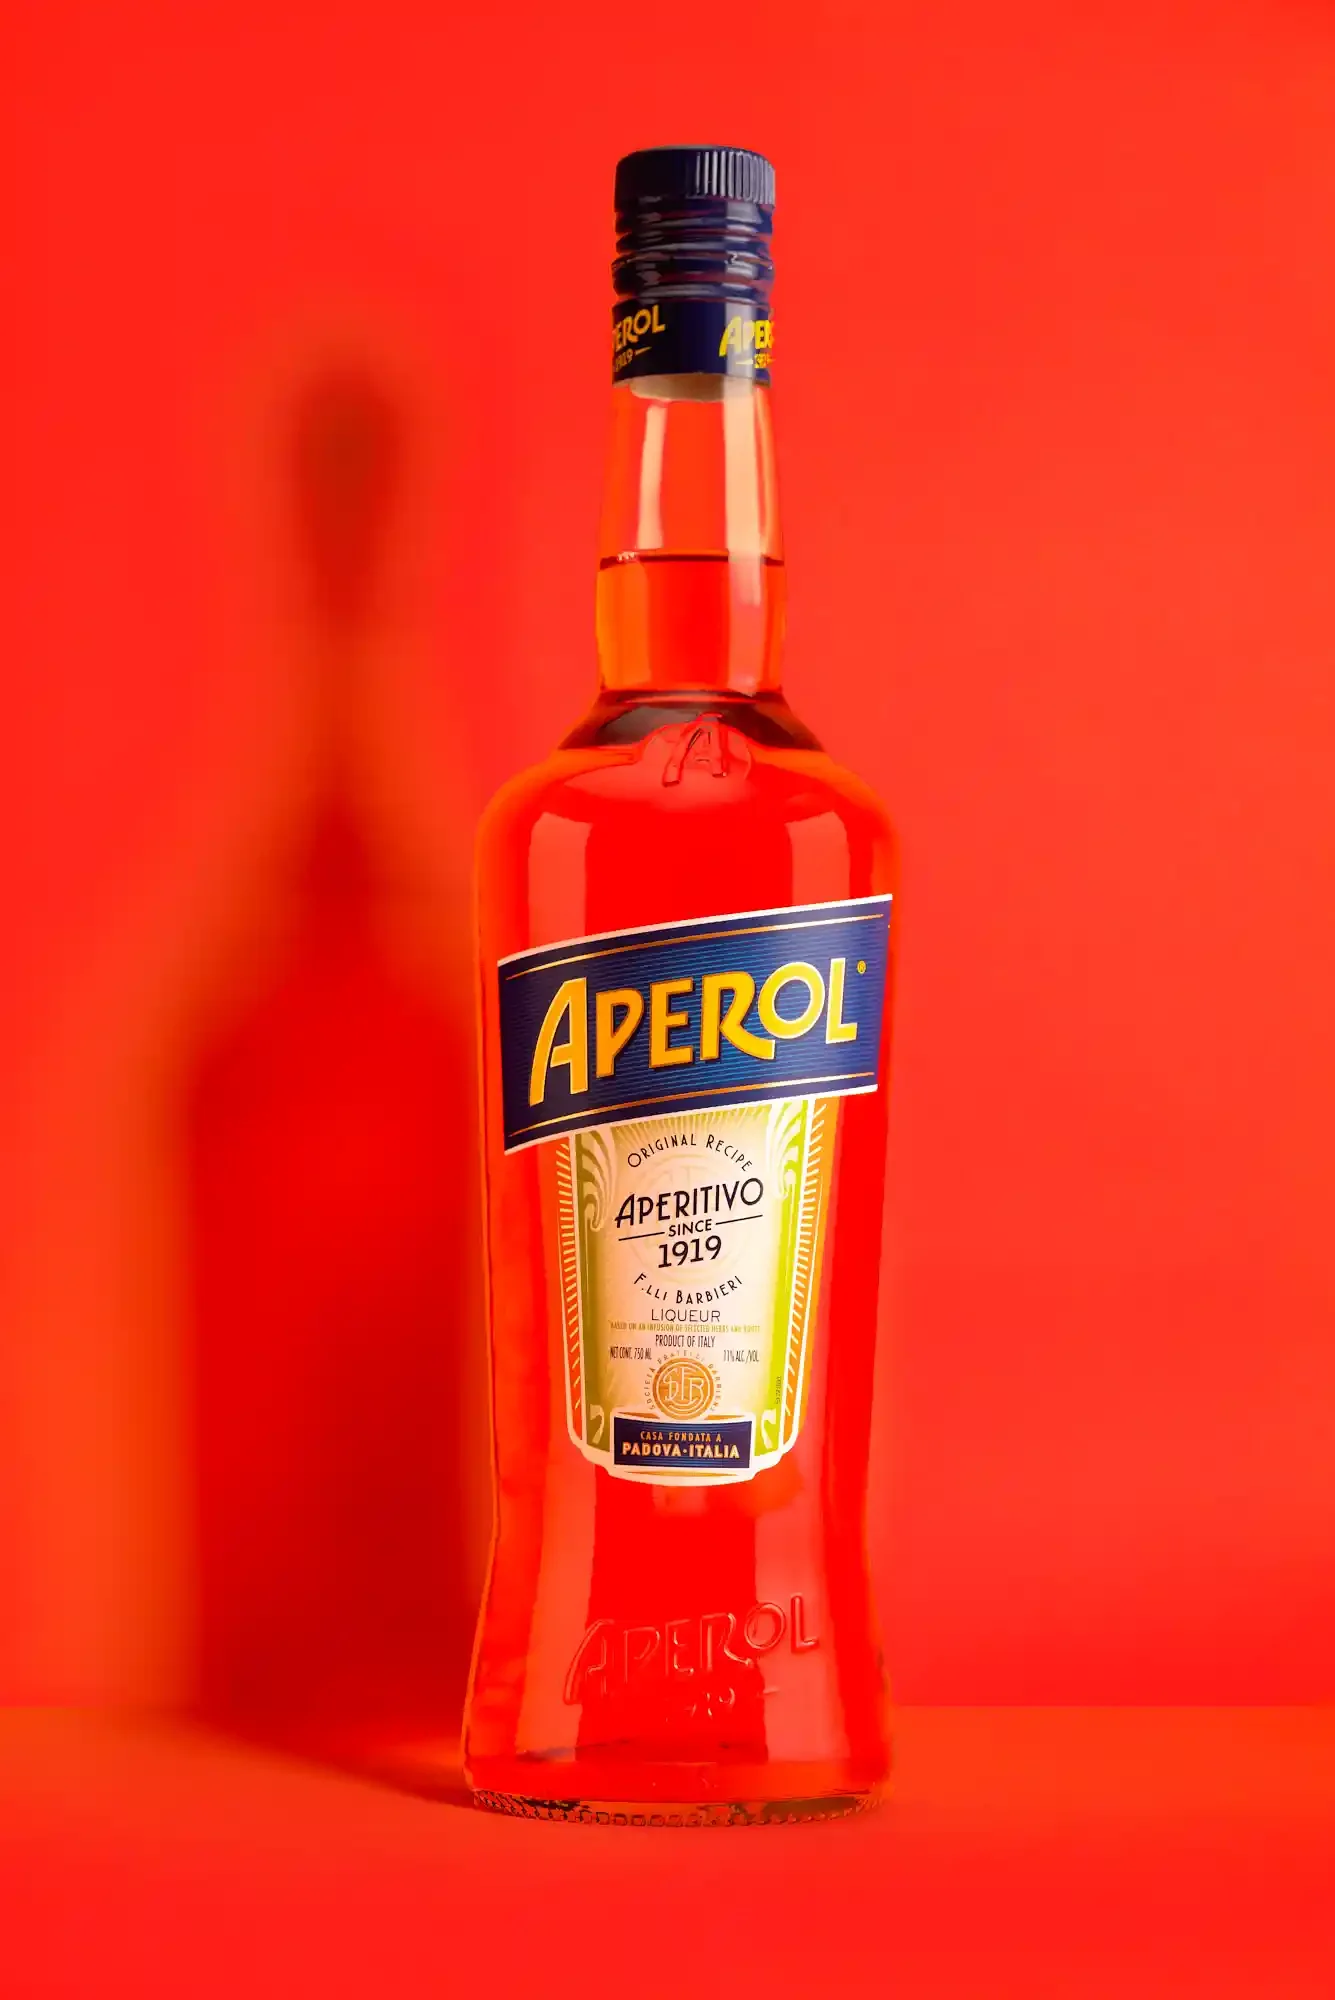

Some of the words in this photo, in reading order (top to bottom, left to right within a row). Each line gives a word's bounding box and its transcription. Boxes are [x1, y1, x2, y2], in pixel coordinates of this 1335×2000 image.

[627, 1133, 697, 1167] ORIGINAL
[705, 1134, 753, 1172] RECIPE
[614, 1177, 764, 1228] APERITIVO
[668, 1218, 712, 1237] SINCE
[658, 1235, 722, 1268] 1919
[633, 1273, 667, 1301] F.LLI
[675, 1275, 743, 1305] BARBIERI
[651, 1308, 721, 1323] LIQUEUR
[655, 1335, 685, 1347] PRODUCT
[687, 1335, 695, 1347] OF
[698, 1335, 716, 1348] ITALY
[634, 1347, 643, 1360] 750
[640, 1431, 663, 1440] CASA
[669, 1431, 711, 1442] FONDATA
[716, 1432, 722, 1442] A
